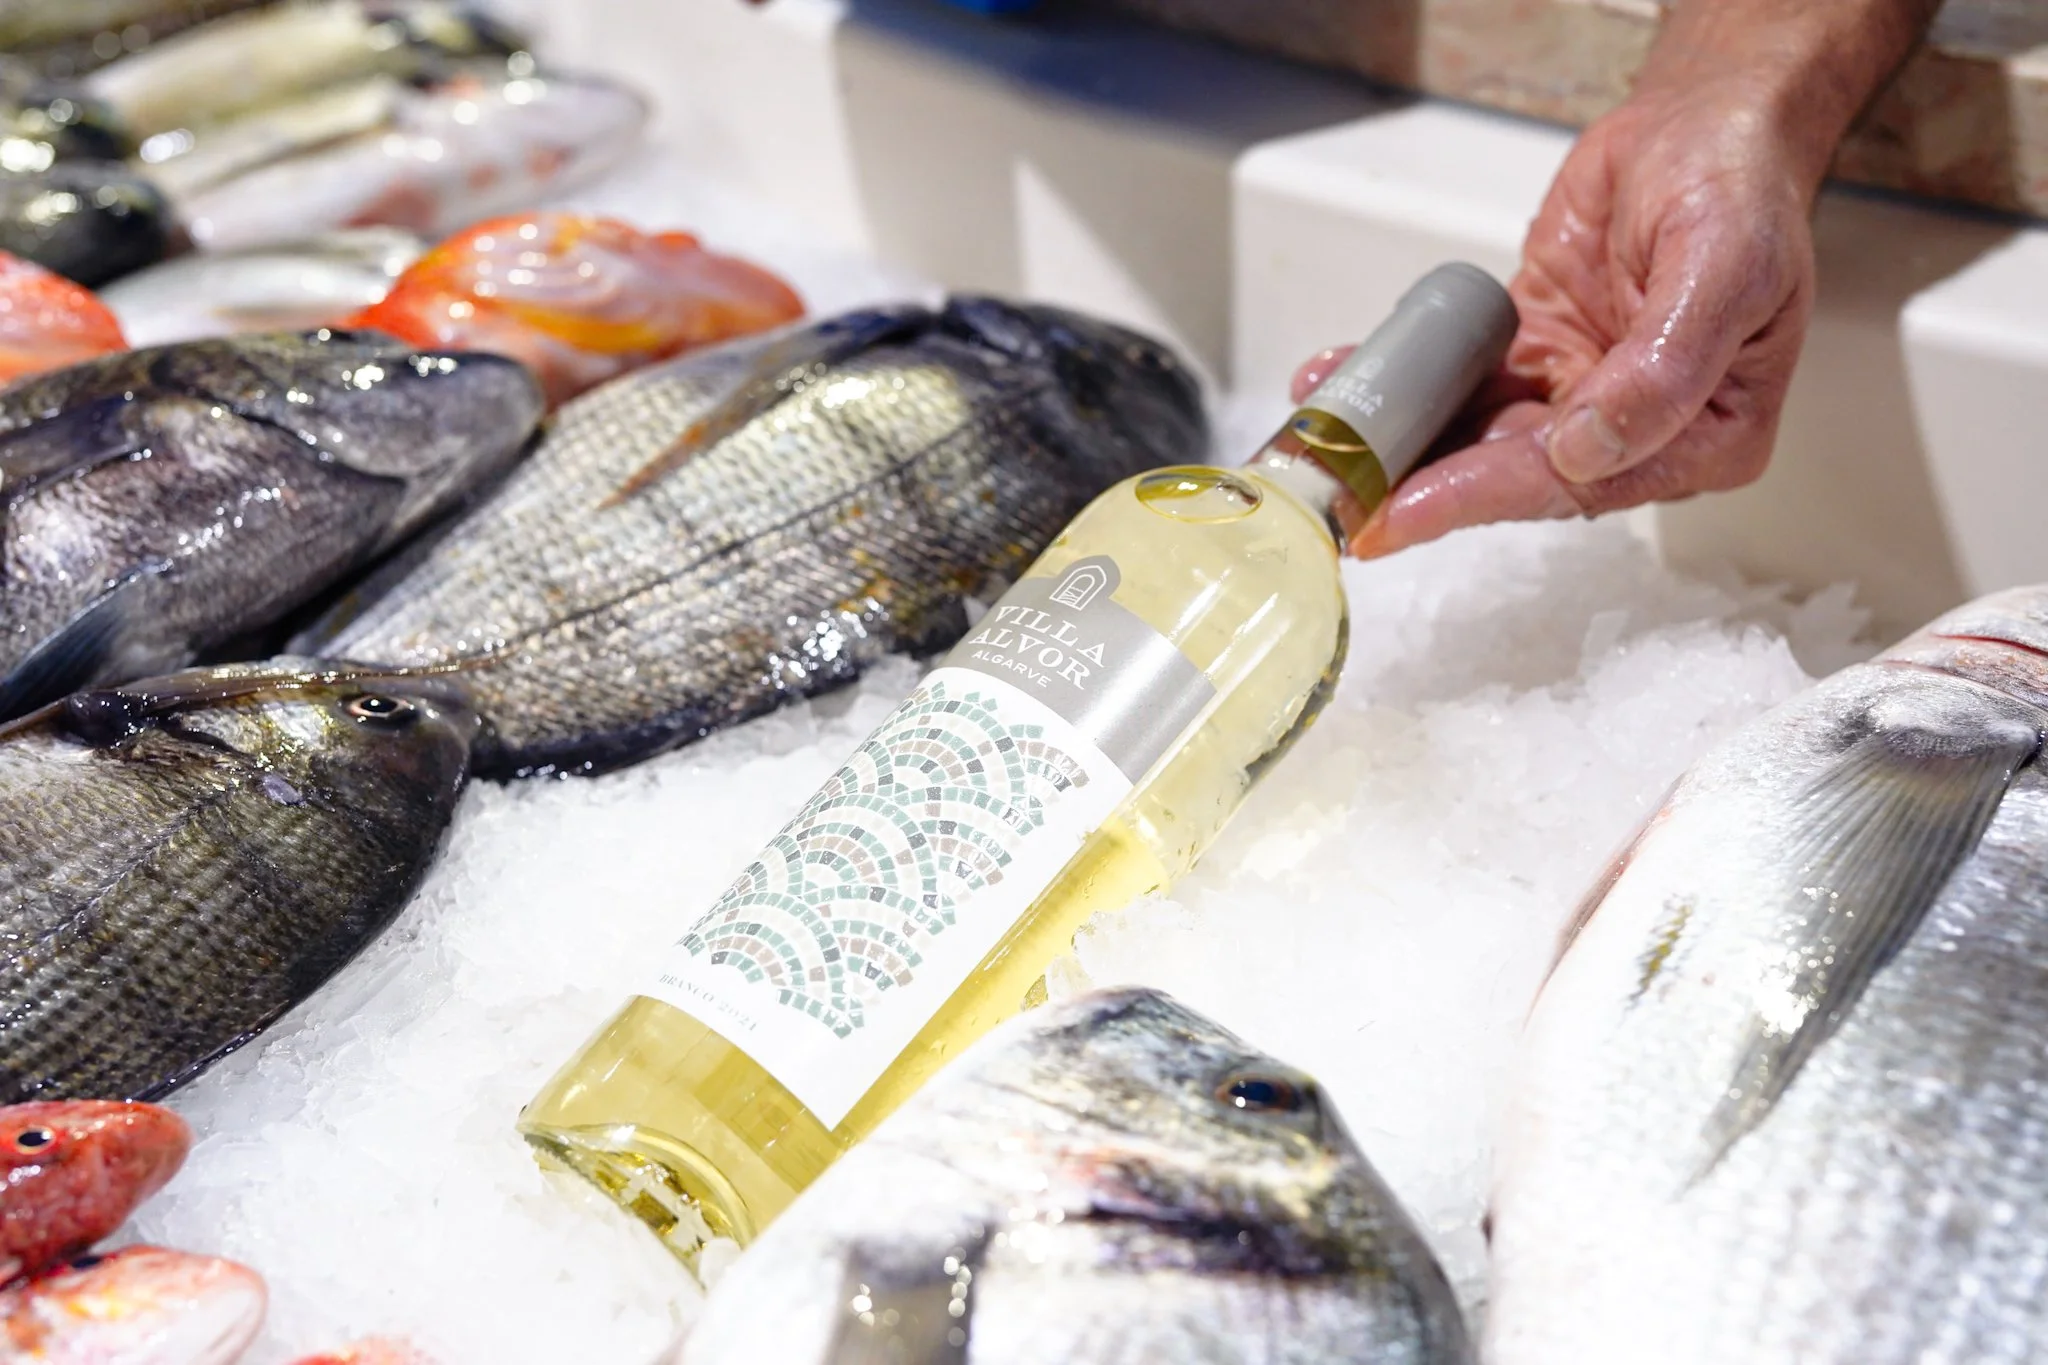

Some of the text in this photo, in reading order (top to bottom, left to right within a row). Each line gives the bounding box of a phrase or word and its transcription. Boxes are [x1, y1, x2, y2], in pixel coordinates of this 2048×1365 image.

[968, 628, 1091, 690] ALVOR
[994, 606, 1106, 668] VILLA
[972, 650, 1052, 688] ALGARVE
[659, 975, 715, 1002] BRANCO
